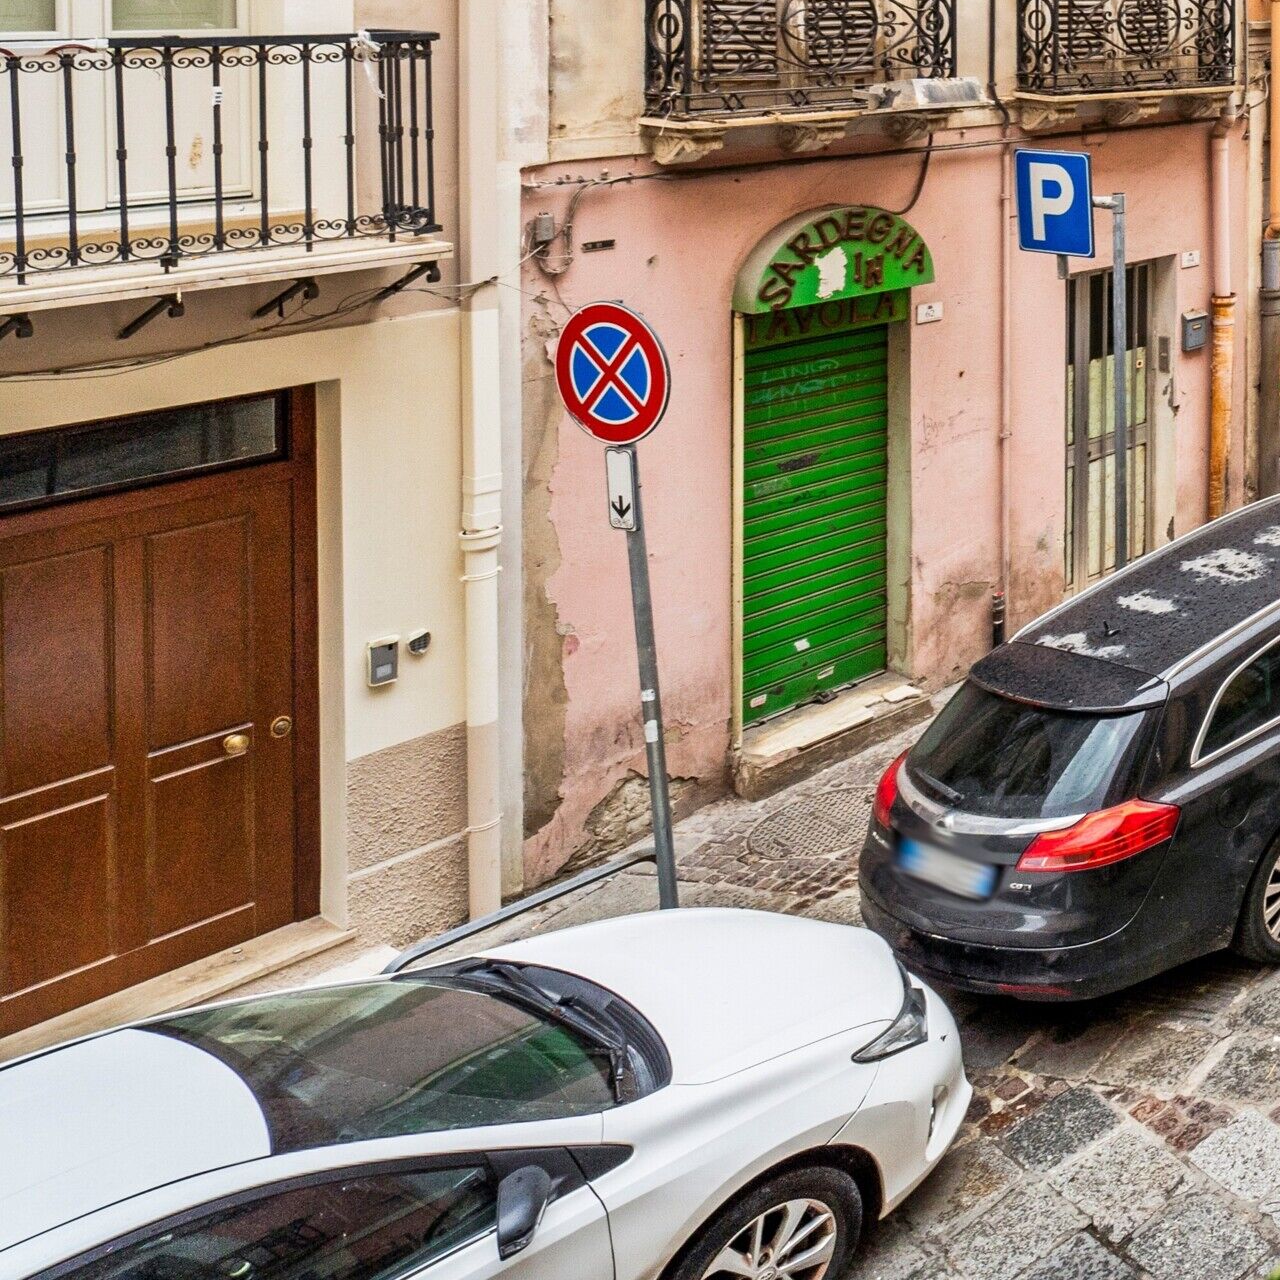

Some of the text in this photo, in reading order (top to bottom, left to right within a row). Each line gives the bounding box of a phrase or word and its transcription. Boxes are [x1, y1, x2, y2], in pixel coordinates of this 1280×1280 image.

[1029, 162, 1074, 241] P
[758, 208, 927, 311] SARDEGNA
[853, 251, 885, 289] IN
[746, 292, 896, 345] TAVOLA
